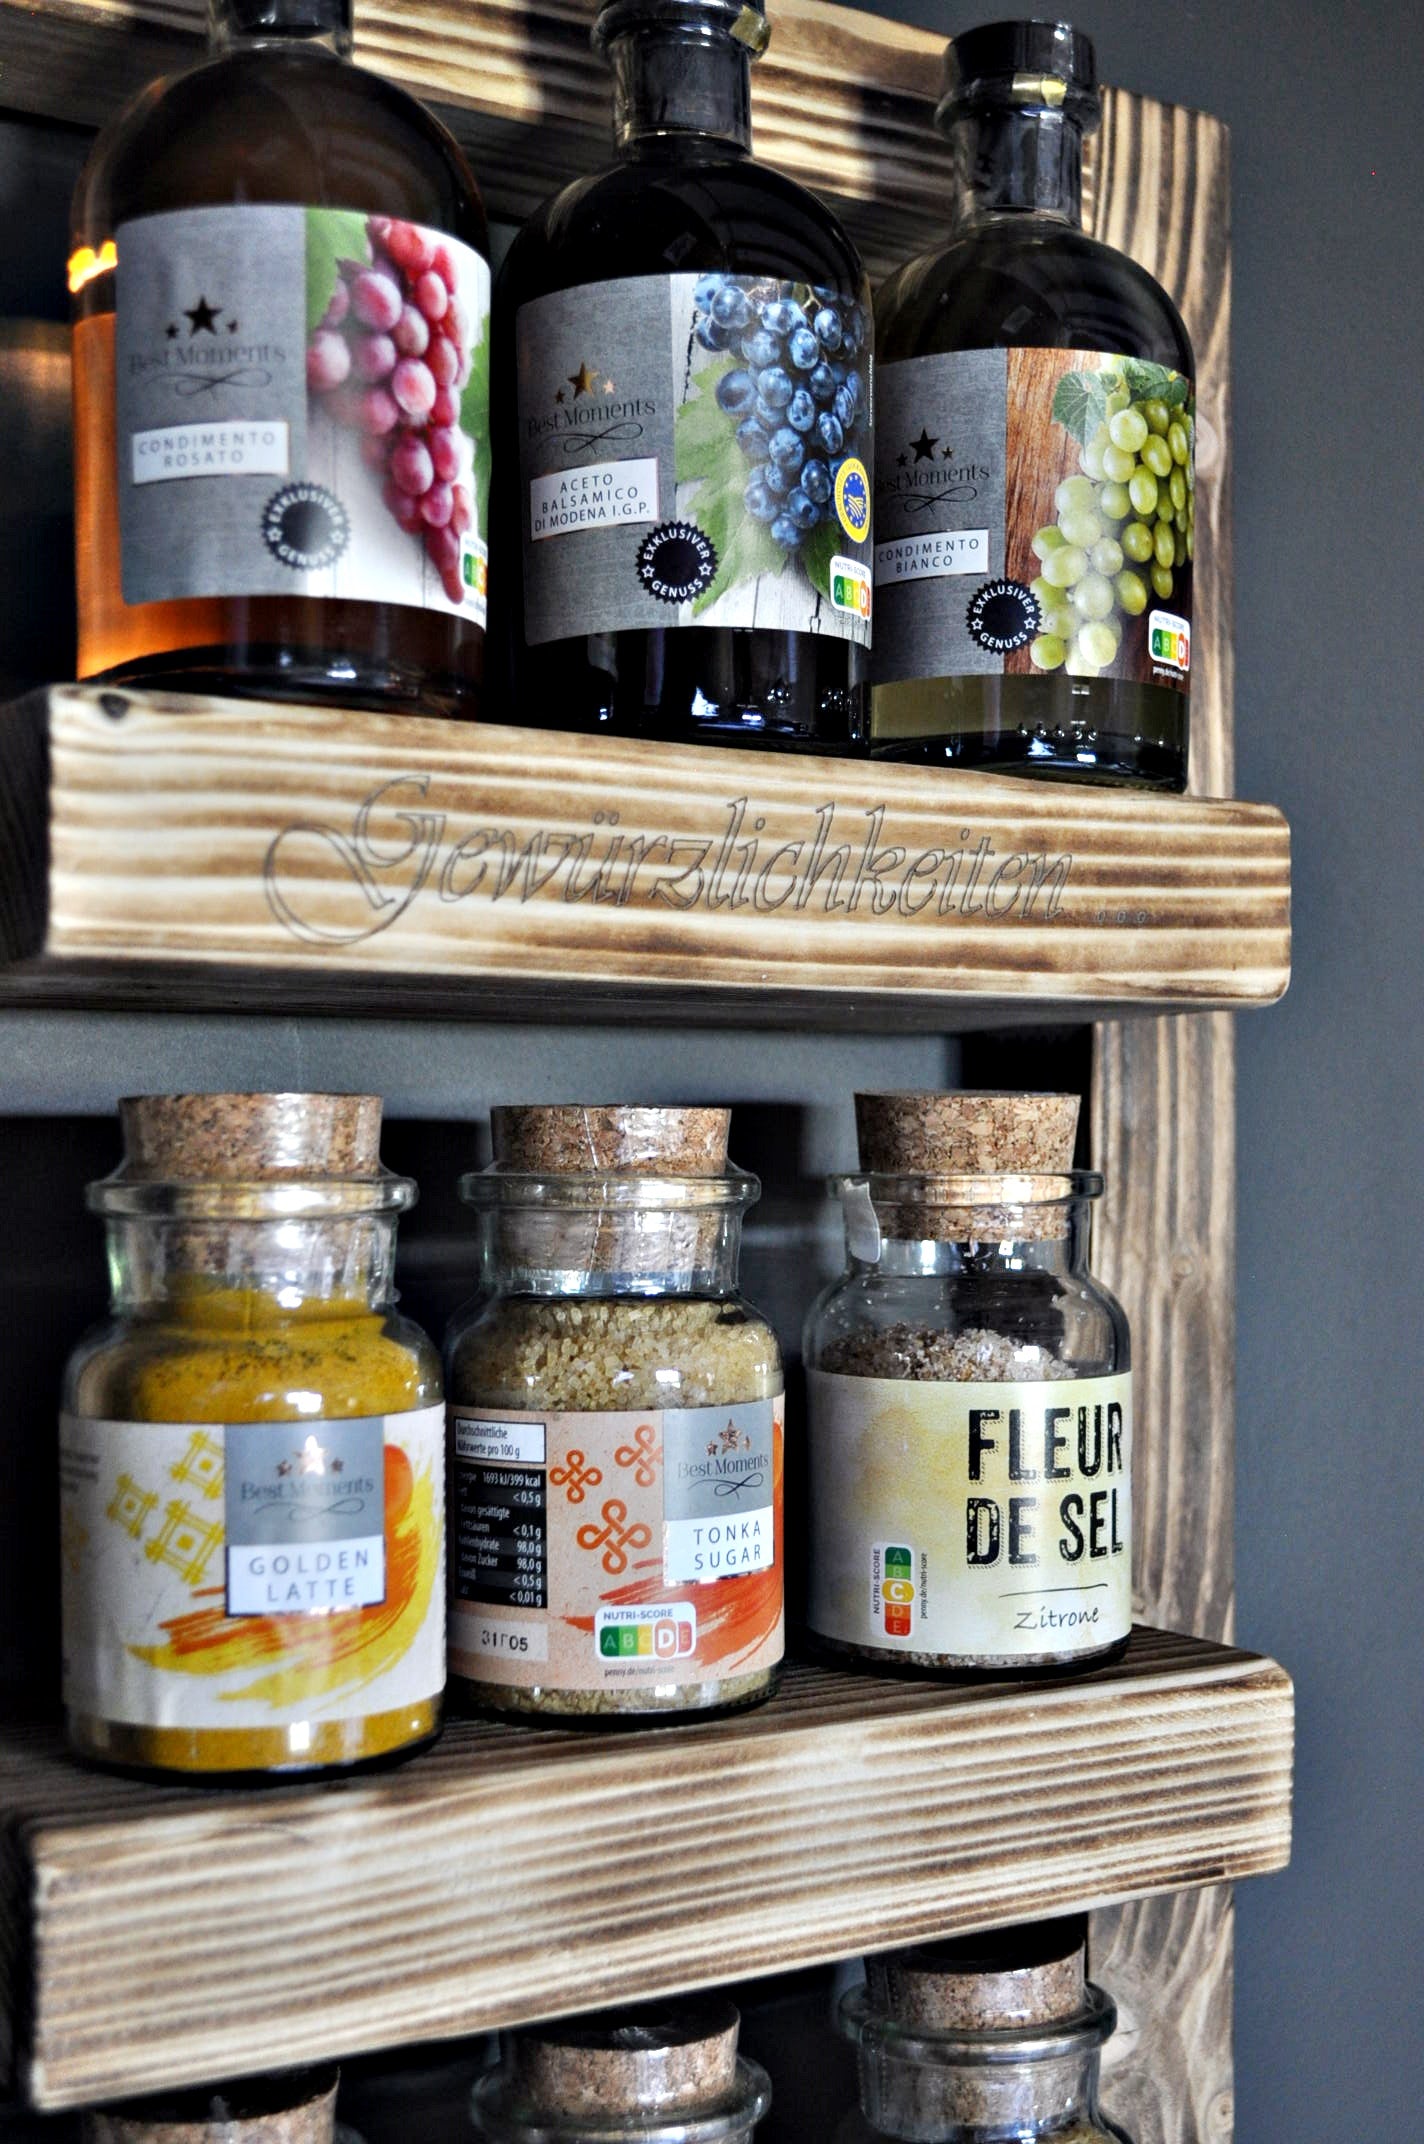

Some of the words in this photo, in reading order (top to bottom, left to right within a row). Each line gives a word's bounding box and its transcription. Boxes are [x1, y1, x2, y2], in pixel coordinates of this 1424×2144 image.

[564, 399, 657, 426] Moments
[138, 431, 276, 456] CONDIMENTO
[164, 450, 244, 468] ROSATO
[560, 473, 614, 494] ACETO
[905, 464, 990, 489] Moments
[542, 487, 639, 514] BALSAMICO
[534, 519, 546, 532] DI
[550, 507, 607, 528] MODENA
[612, 502, 651, 517] I.G.P.
[643, 528, 711, 561] EXKLUSIVER
[879, 538, 979, 563] CONDIMENTO
[896, 555, 953, 574] BIANCO
[652, 578, 704, 599] GENUSS
[973, 585, 1035, 615] EXKLUSIVER
[980, 631, 1028, 649] GENUSS
[264, 774, 1074, 946] Gewürzlichkeiten
[488, 1446, 499, 1457] pro
[501, 1444, 514, 1457] 100
[968, 1403, 1123, 1481] FLEUR
[678, 1459, 713, 1479] Best
[716, 1453, 769, 1476] Moments
[525, 1474, 541, 1488] kcal
[693, 1520, 761, 1546] TONKA
[966, 1497, 1038, 1566] DE
[1058, 1488, 1123, 1562] SEL
[248, 1550, 369, 1576] GOLDEN
[695, 1544, 761, 1570] SUGAR
[267, 1576, 355, 1602] LATTE
[603, 1608, 674, 1621] NUTRI-SCORE
[1013, 1606, 1100, 1630] Zitrone
